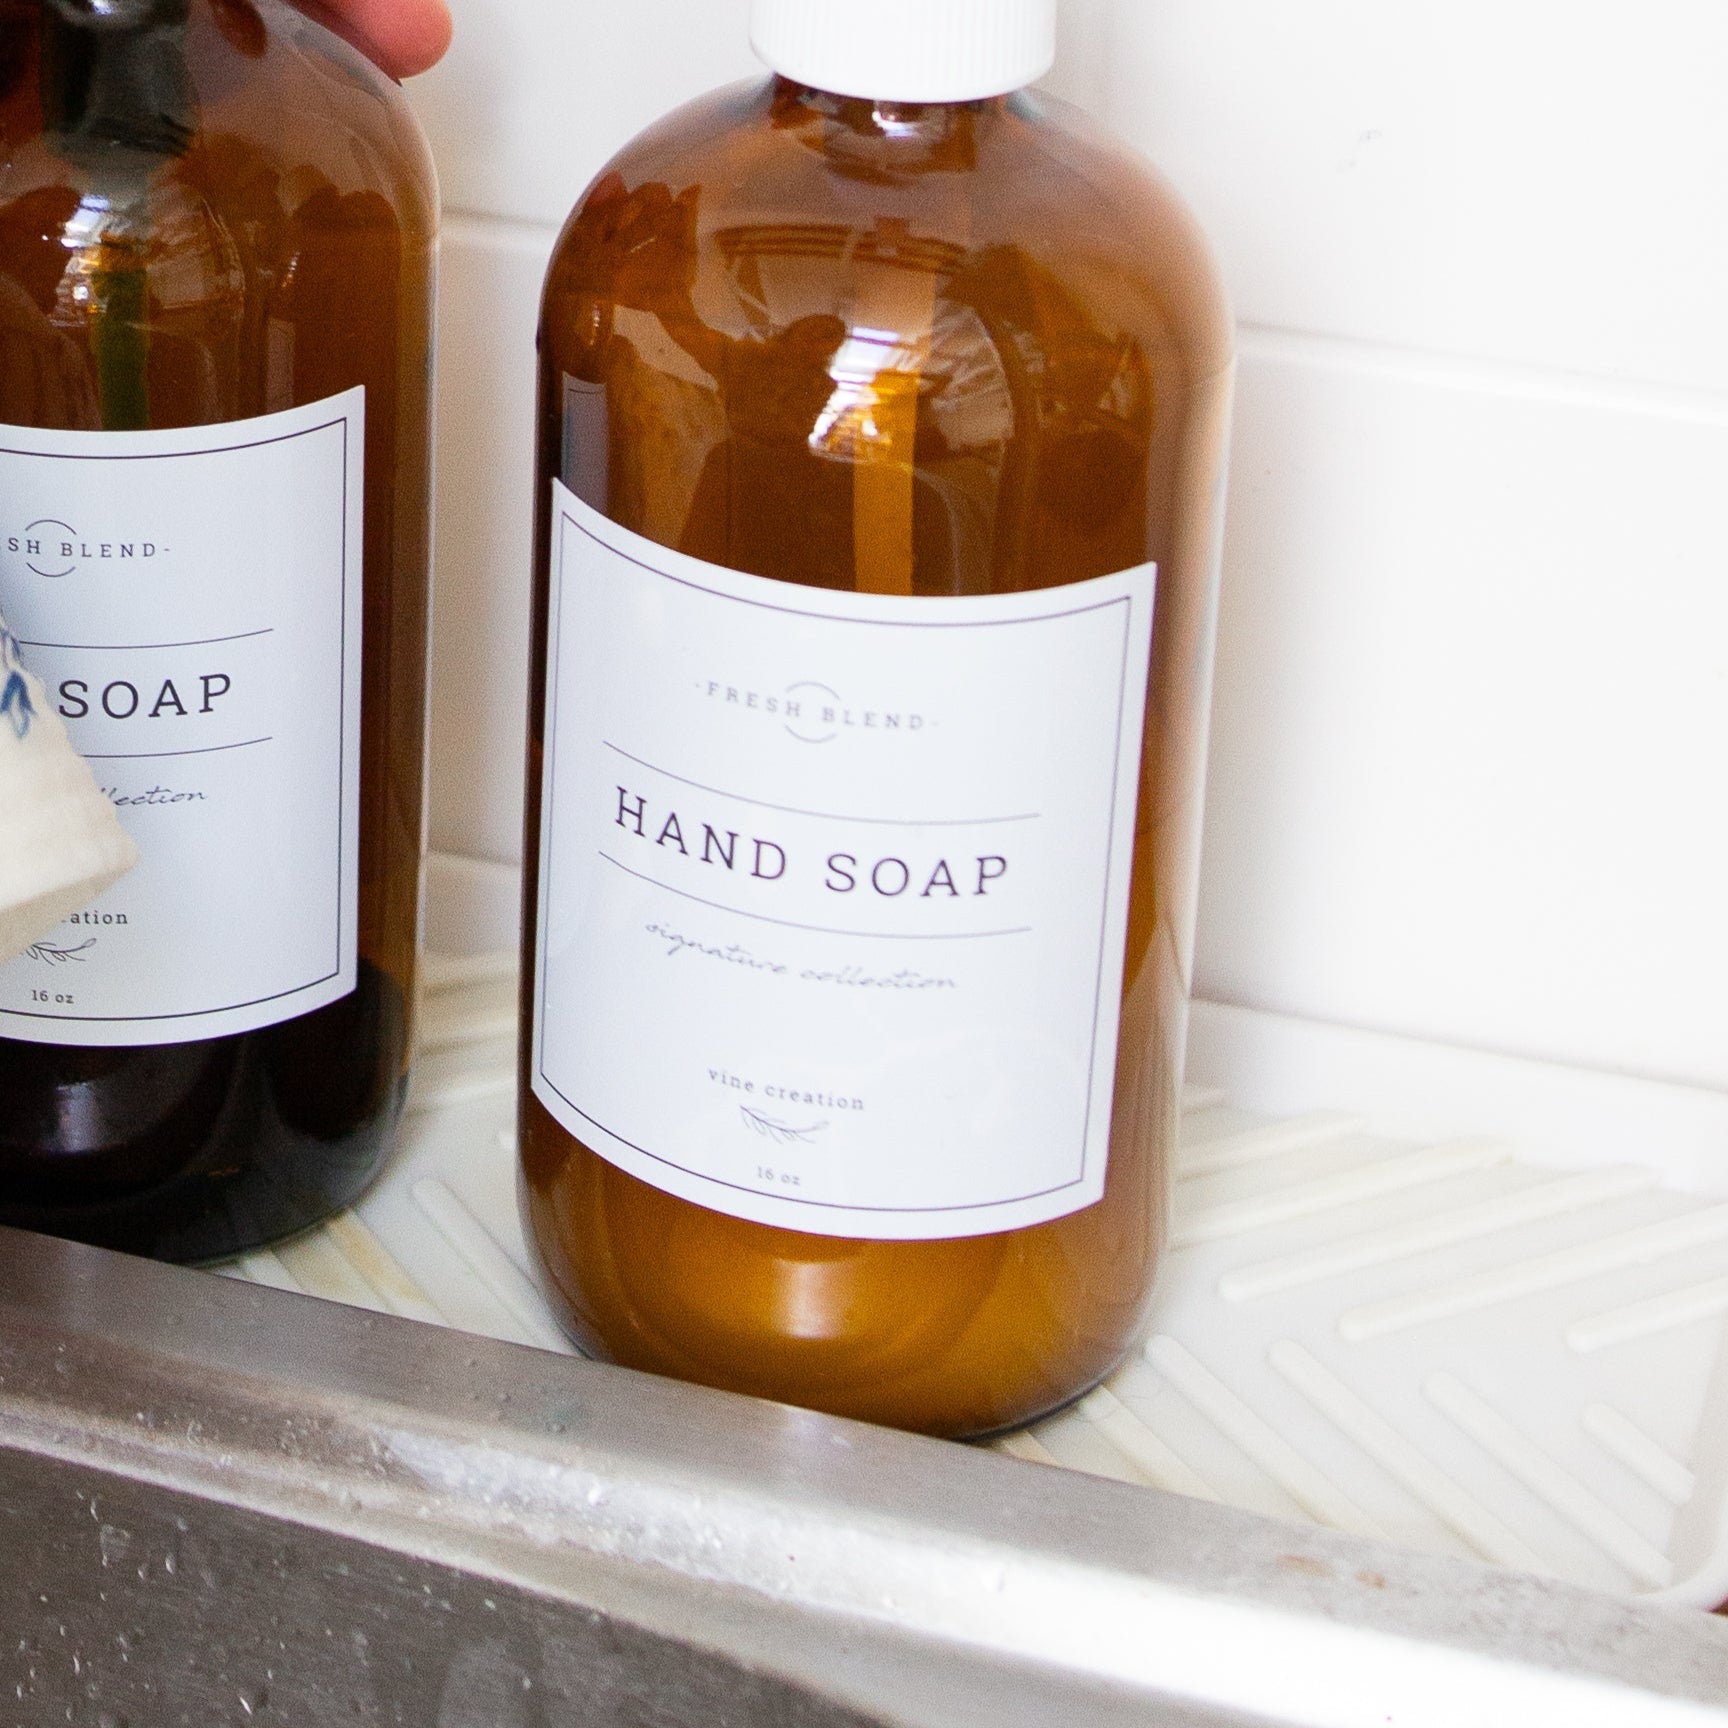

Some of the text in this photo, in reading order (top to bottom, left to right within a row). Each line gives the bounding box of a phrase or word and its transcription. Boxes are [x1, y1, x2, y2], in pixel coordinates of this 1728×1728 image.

[57, 673, 231, 720] SOAP
[615, 785, 1008, 898] HAND SOAP
[61, 910, 128, 925] ation
[645, 923, 956, 988] signature collection
[31, 989, 75, 1005] 16 oz
[707, 1068, 865, 1111] vine creation
[757, 1165, 801, 1186] 16 oz
